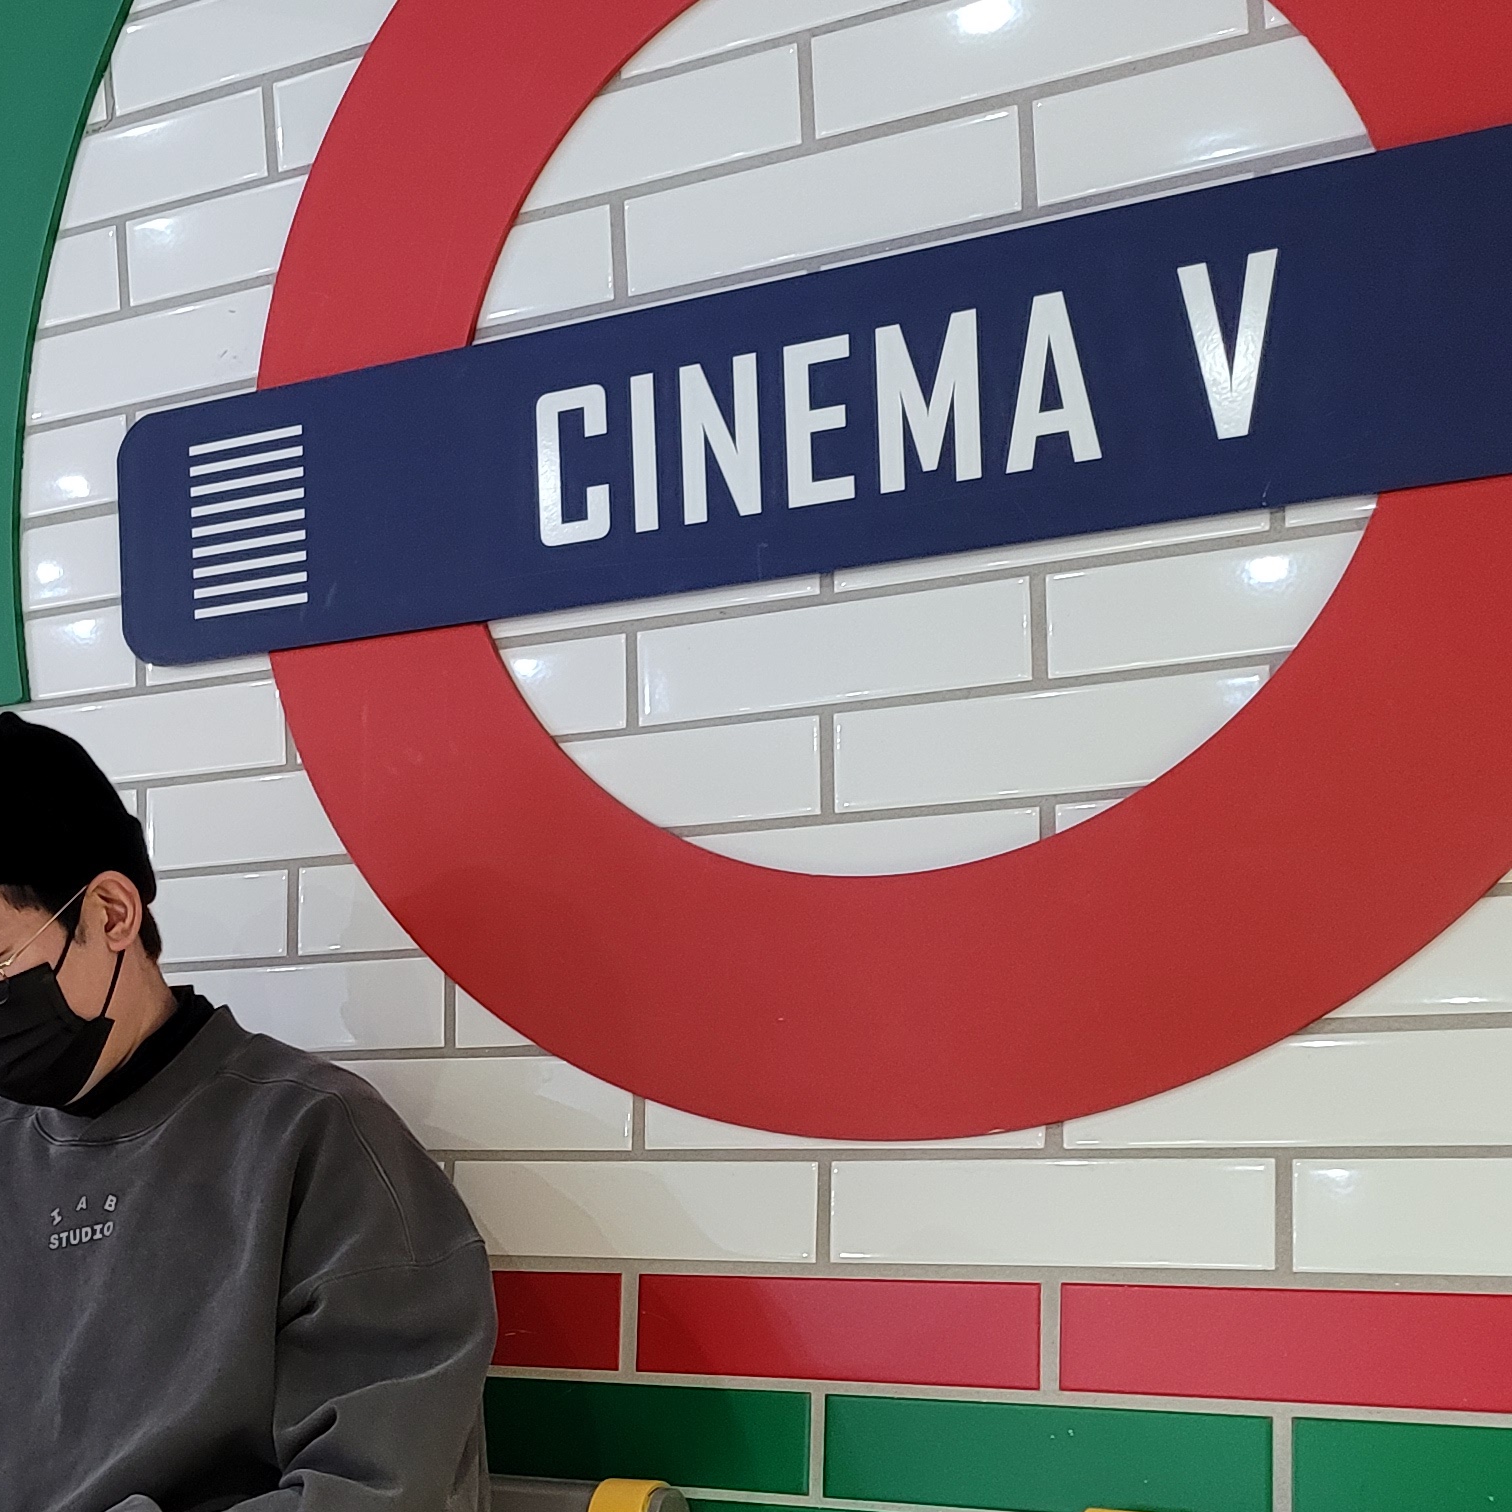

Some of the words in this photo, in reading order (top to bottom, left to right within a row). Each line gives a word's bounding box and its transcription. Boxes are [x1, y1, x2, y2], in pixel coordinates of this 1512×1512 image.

[535, 290, 1103, 547] CINEMA
[1176, 248, 1279, 440] V
[48, 1221, 114, 1250] STUDIO
